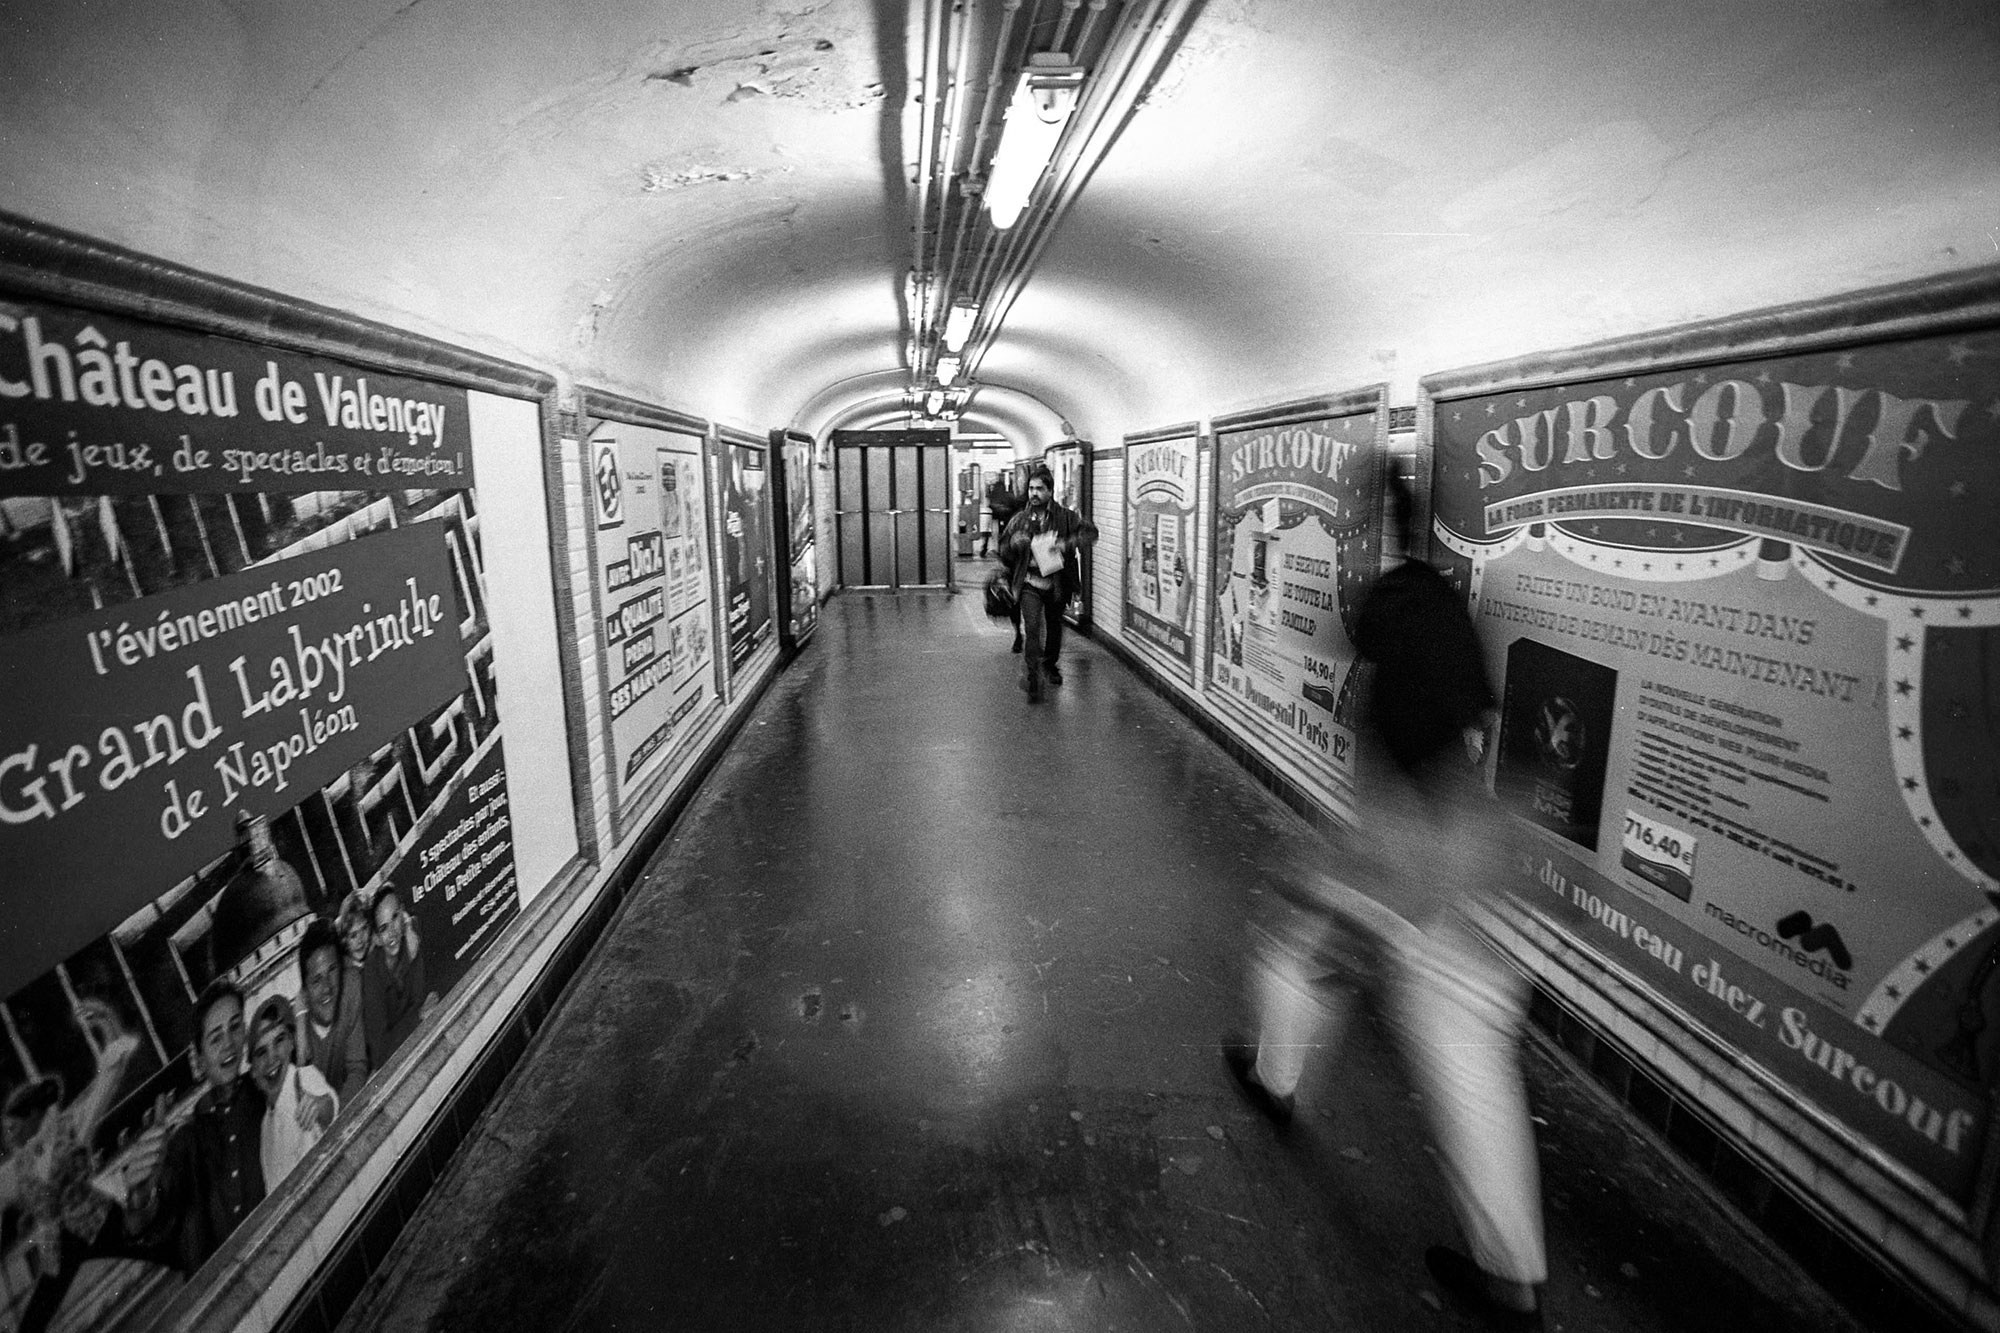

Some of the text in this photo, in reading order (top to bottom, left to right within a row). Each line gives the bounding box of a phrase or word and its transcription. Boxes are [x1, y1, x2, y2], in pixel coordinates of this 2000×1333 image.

[0, 315, 446, 447] Château de Valençay
[0, 423, 50, 470] de
[67, 430, 163, 485] jeux,
[172, 434, 212, 473] de
[222, 442, 349, 484] spectacles
[353, 452, 373, 476] et
[1134, 446, 1191, 480] SURCOUF
[1231, 430, 1351, 483] SURCOUF
[1475, 379, 1972, 491] SURCOUF
[1488, 491, 1899, 560] LA FOIRE PERMANENTE DE L'INFORMATIQUE
[87, 568, 344, 675] l'événement 2002
[608, 619, 622, 640] LA
[1320, 591, 1334, 612] LA
[1516, 573, 1563, 599] FAITES
[1590, 585, 1636, 612] BOND
[1638, 593, 1666, 617] EN
[1667, 599, 1742, 632] AVANT
[1743, 611, 1817, 645] DANS
[1558, 614, 1579, 636] DE
[1580, 619, 1648, 651] DEMAIN
[1690, 642, 1860, 703] MAINTENANT
[0, 577, 444, 823] Grand Labyrinthe
[610, 683, 631, 716] SES
[1298, 707, 1329, 753] Paris
[160, 704, 360, 840] de Napoléon
[1705, 901, 1851, 990] macromedia
[1539, 858, 1973, 1154] du nouveau chez Surcouf
